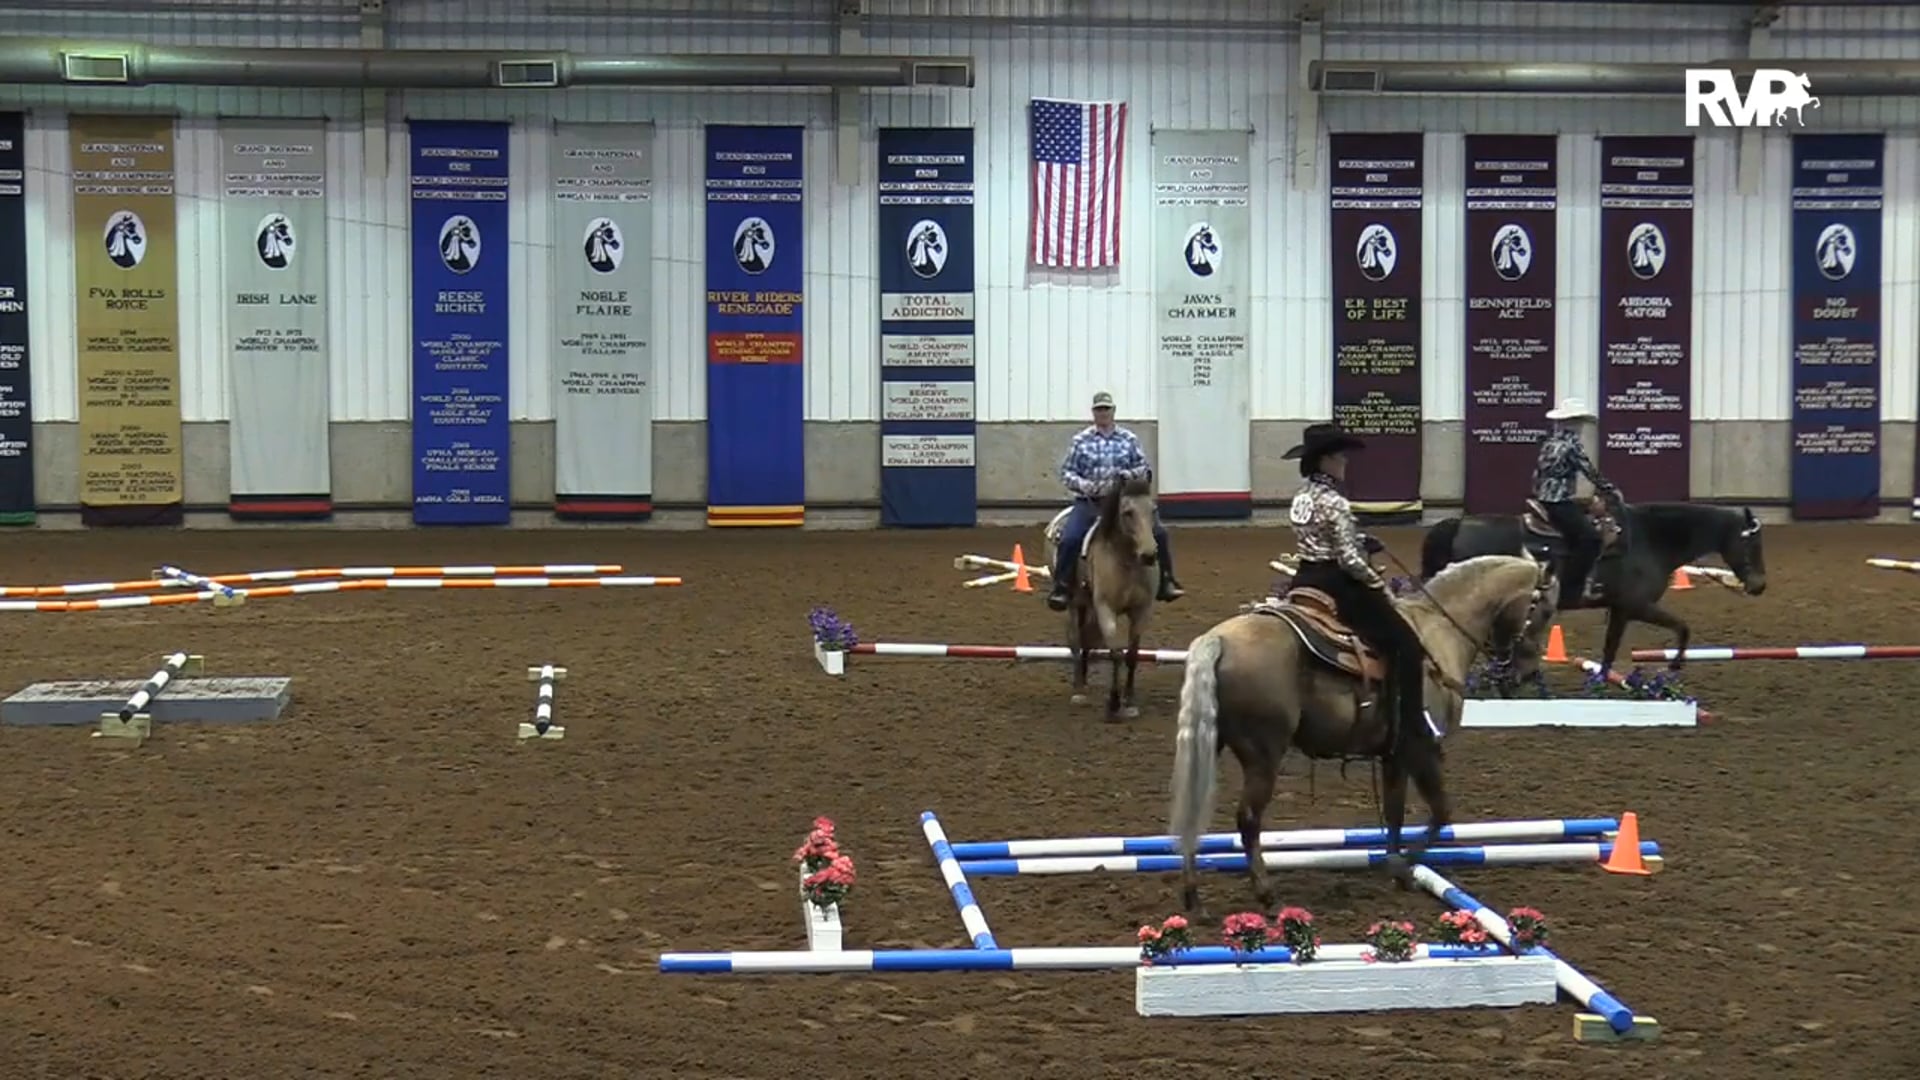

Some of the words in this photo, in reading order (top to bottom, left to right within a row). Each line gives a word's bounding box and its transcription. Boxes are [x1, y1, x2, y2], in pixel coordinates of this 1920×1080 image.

[123, 288, 164, 298] ROLLS
[438, 291, 483, 302] REESE
[581, 291, 628, 302] NOBLE
[707, 291, 749, 302] RIVER
[756, 291, 803, 302] RIDERS
[237, 293, 270, 304] IRISH
[279, 293, 317, 304] LANE
[904, 295, 951, 306] TOTAL
[1183, 294, 1222, 304] JAVA'S
[1373, 298, 1409, 309] BEST
[1470, 298, 1552, 309] BENNFIELDS
[1826, 297, 1847, 307] NO
[106, 300, 149, 310] ROYCE
[435, 303, 487, 313] RICHEY
[718, 303, 793, 315] RENEGADE
[576, 305, 632, 316] FLAIRE
[891, 307, 965, 317] ADDICTION
[1168, 307, 1237, 318] CHARMER
[1347, 309, 1367, 320] OF
[1372, 309, 1406, 320] LIFE
[1498, 309, 1525, 319] ACE
[1625, 308, 1667, 318] SATORI
[1813, 307, 1859, 319] DOUBT
[239, 337, 270, 345] WORLD
[889, 343, 920, 351] WORLD
[922, 343, 969, 351] CHAMPION
[1609, 343, 1637, 351] WORLD
[1639, 343, 1681, 351] CHAMPION
[1608, 395, 1637, 403] WORLD
[1639, 395, 1680, 403] CHAMPION
[1608, 433, 1636, 441] WORLD
[1639, 433, 1680, 441] CHAMPION
